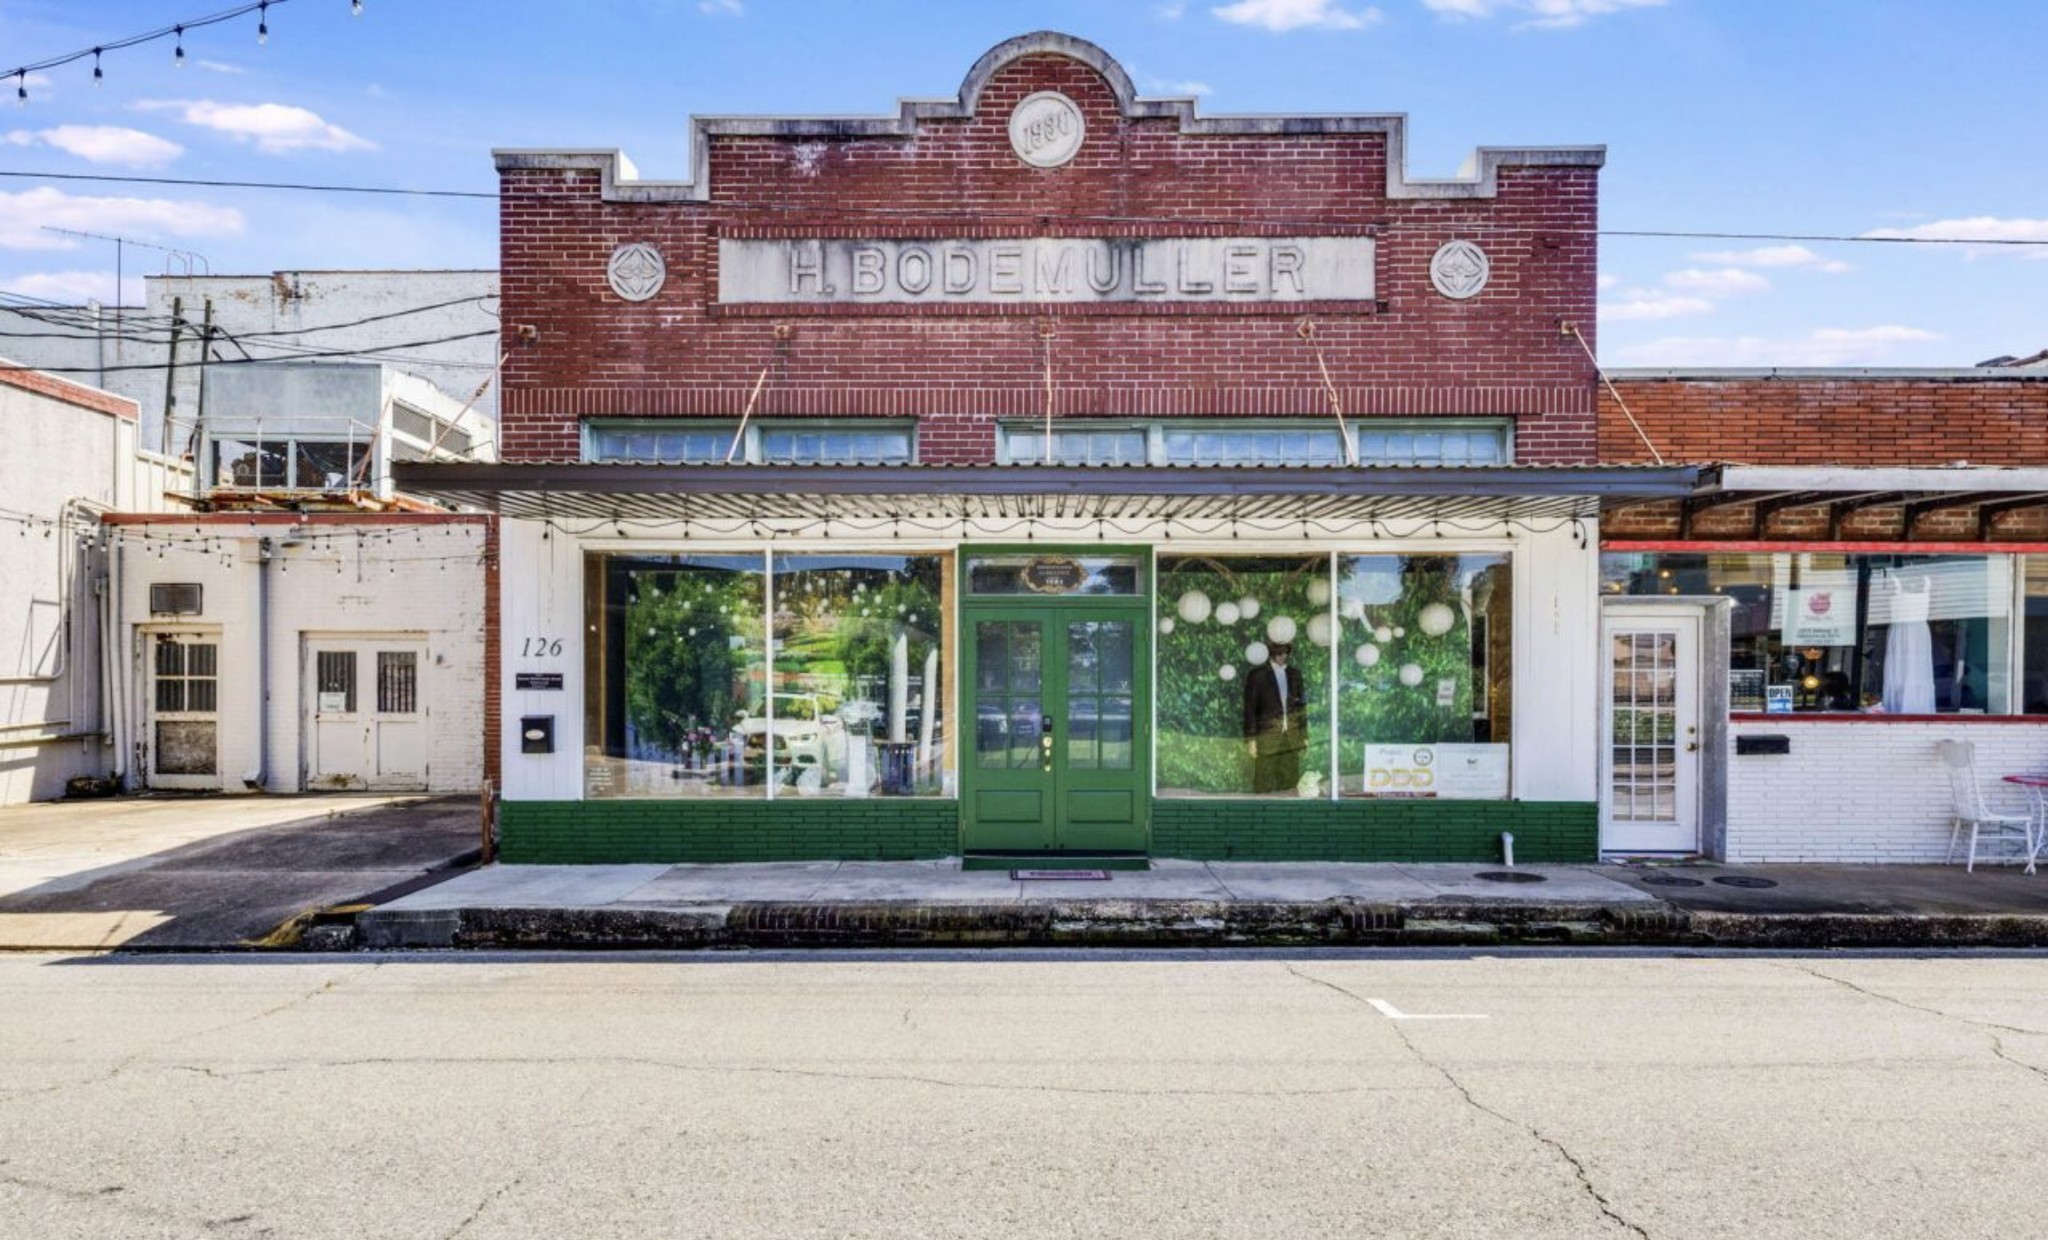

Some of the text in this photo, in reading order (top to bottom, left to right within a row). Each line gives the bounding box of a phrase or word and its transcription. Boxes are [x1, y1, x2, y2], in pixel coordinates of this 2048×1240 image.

[788, 245, 1306, 295] H. BODEMULLER
[522, 637, 564, 657] 126
[1769, 687, 1792, 698] OPEN
